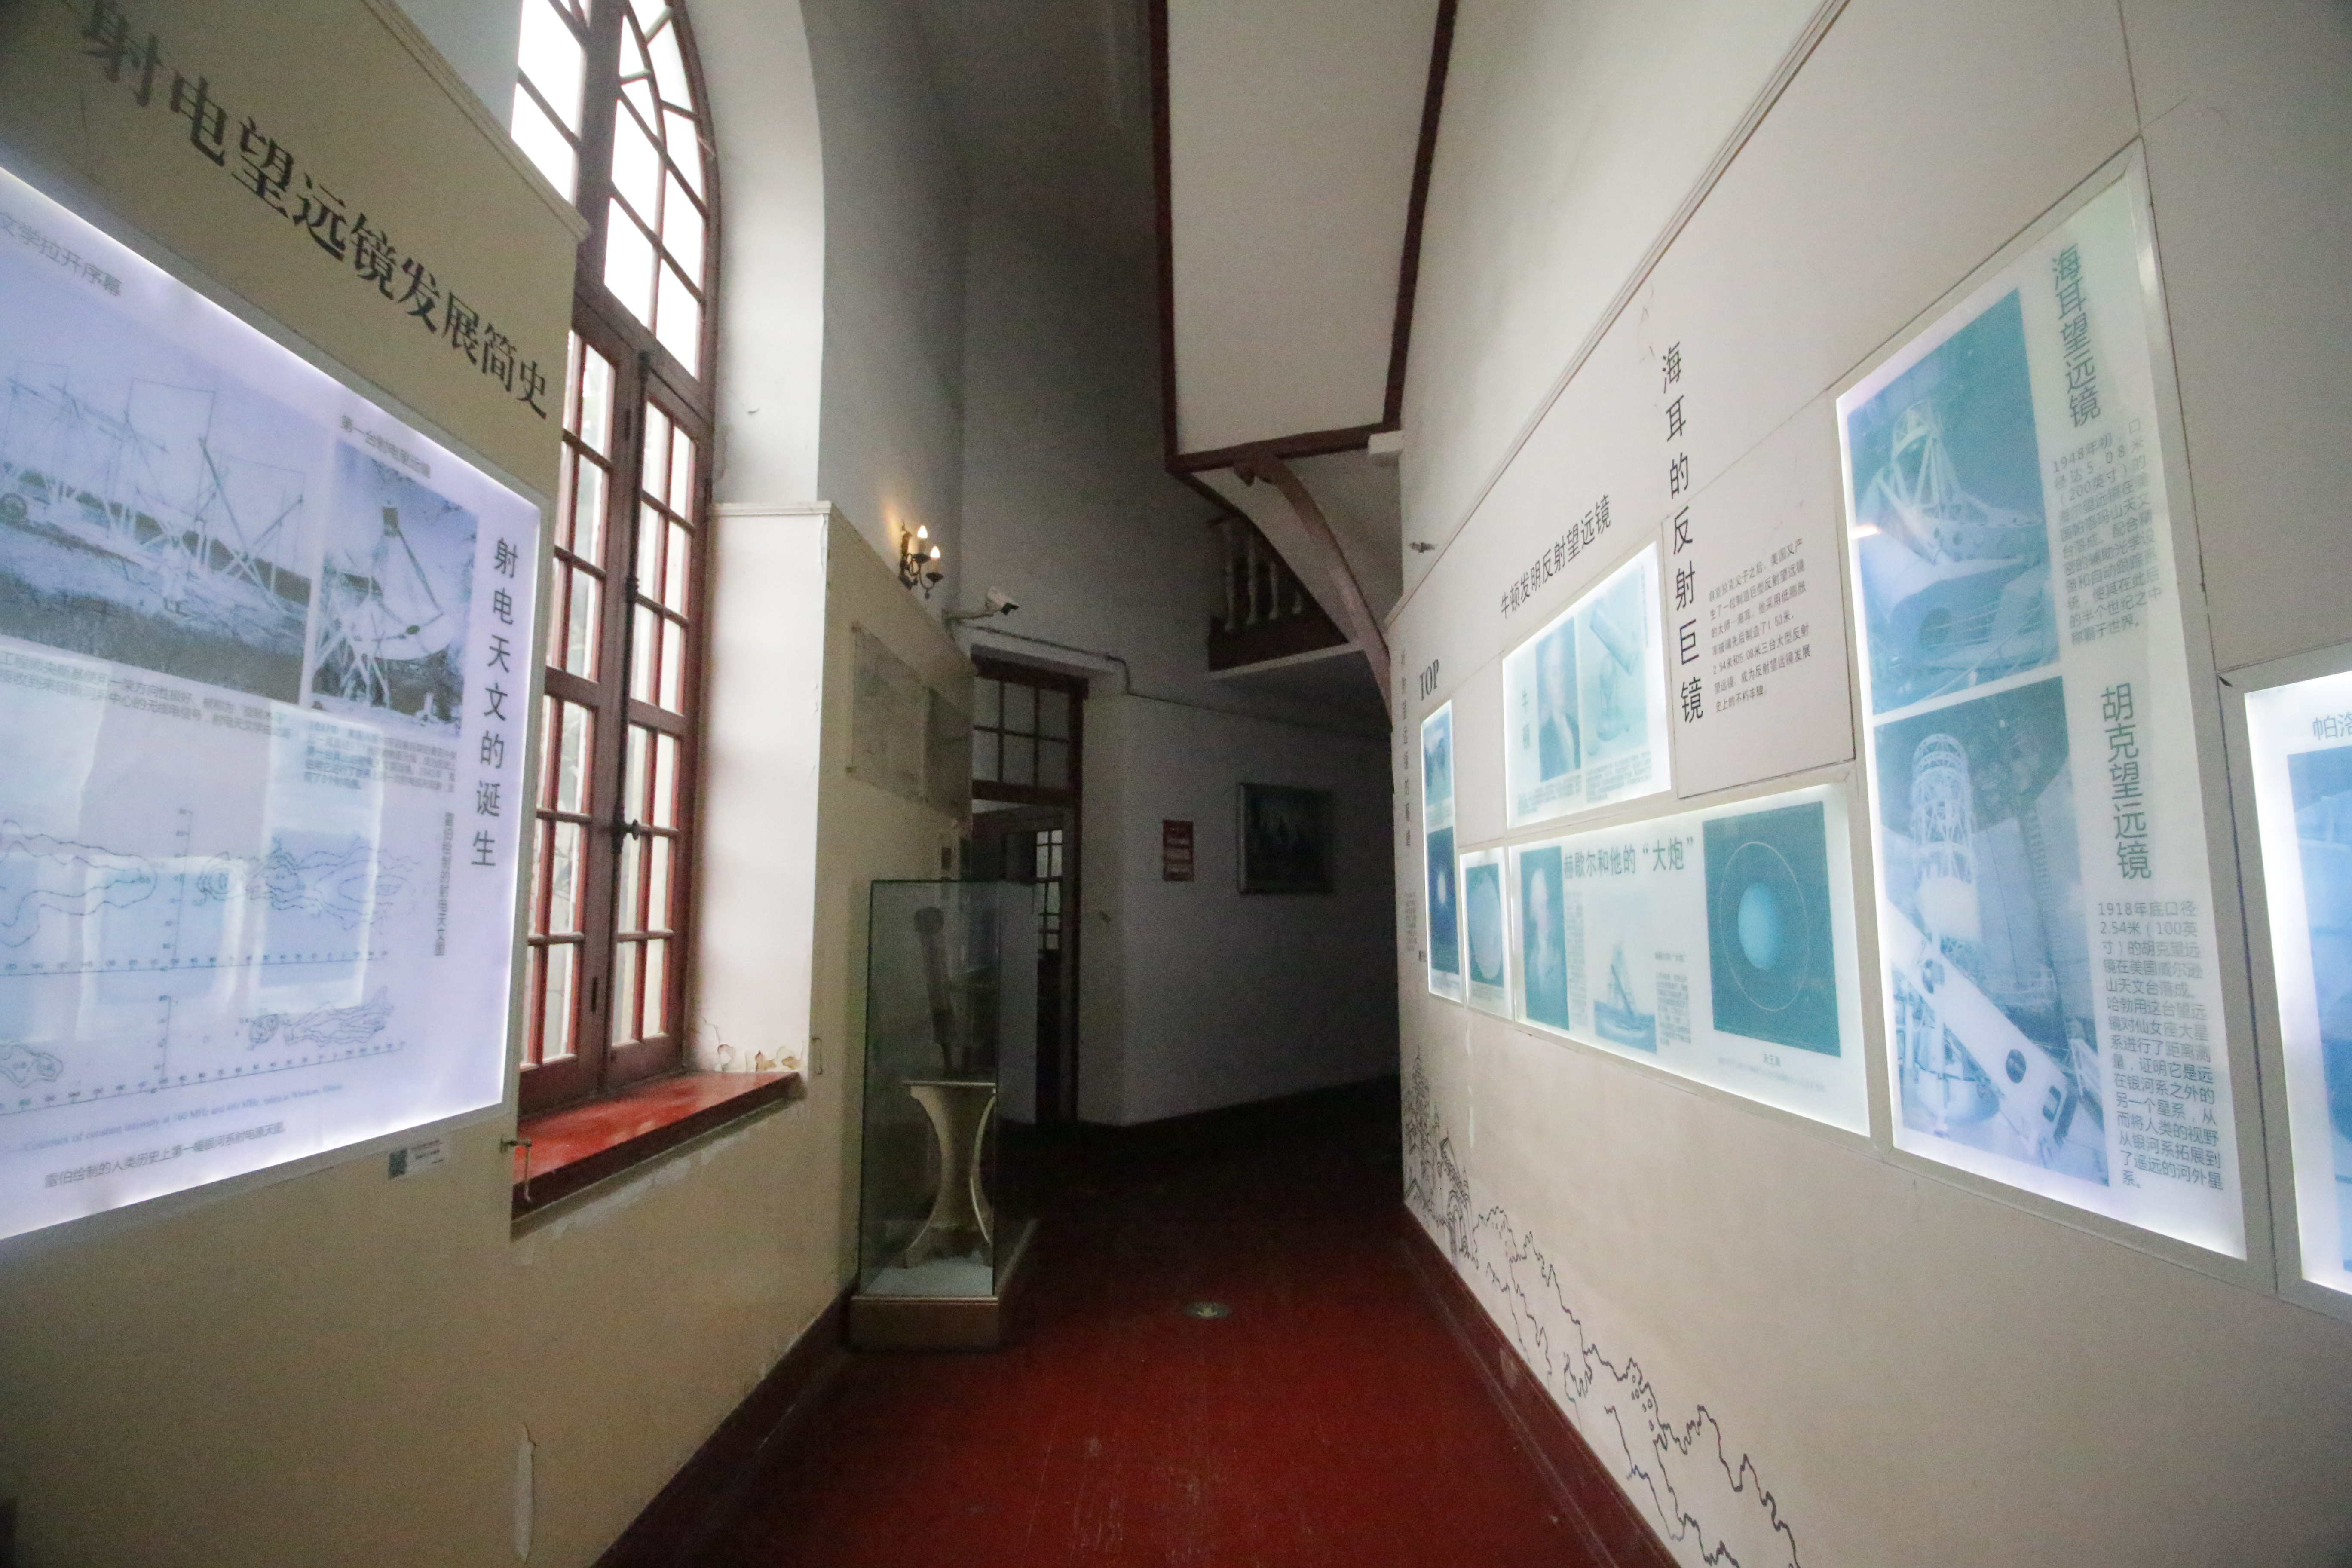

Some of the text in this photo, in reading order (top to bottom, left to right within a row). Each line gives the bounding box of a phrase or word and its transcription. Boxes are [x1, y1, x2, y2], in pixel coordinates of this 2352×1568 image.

[80, 0, 547, 419] 射电望远镜发展简史
[2052, 242, 2101, 428] 海耳望远镜
[1662, 341, 1704, 723] 海耳的反射巨镜
[1500, 494, 1611, 620] 牛顿发明反射望远镜
[1710, 557, 1804, 621] 生了一位制造巨型反射望远镜
[2070, 585, 2161, 629] 的半个世纪之中
[471, 537, 518, 867] 射电天文的诞生
[2100, 682, 2152, 880] 胡克望远镜
[1563, 836, 1694, 879] 赫歇尔和他的“大炮”
[2098, 901, 2196, 917] 1918年底口径
[2104, 958, 2202, 979] 镜在美国威尔逊
[2106, 977, 2195, 998] 山天文台落成。
[2107, 998, 2207, 1020] 哈勃用这台望远
[2109, 1016, 2208, 1041] 镜对仙女座大星
[2111, 1036, 2210, 1063] 系进行了距离测
[2114, 1075, 2215, 1105] 在银河系之外的
[2118, 1113, 2218, 1146] 而将人类的视野
[2120, 1132, 2220, 1168] 从银河系拓展到
[2122, 1152, 2223, 1191] 了遥远的河外星
[2123, 1170, 2141, 1189] 系。
